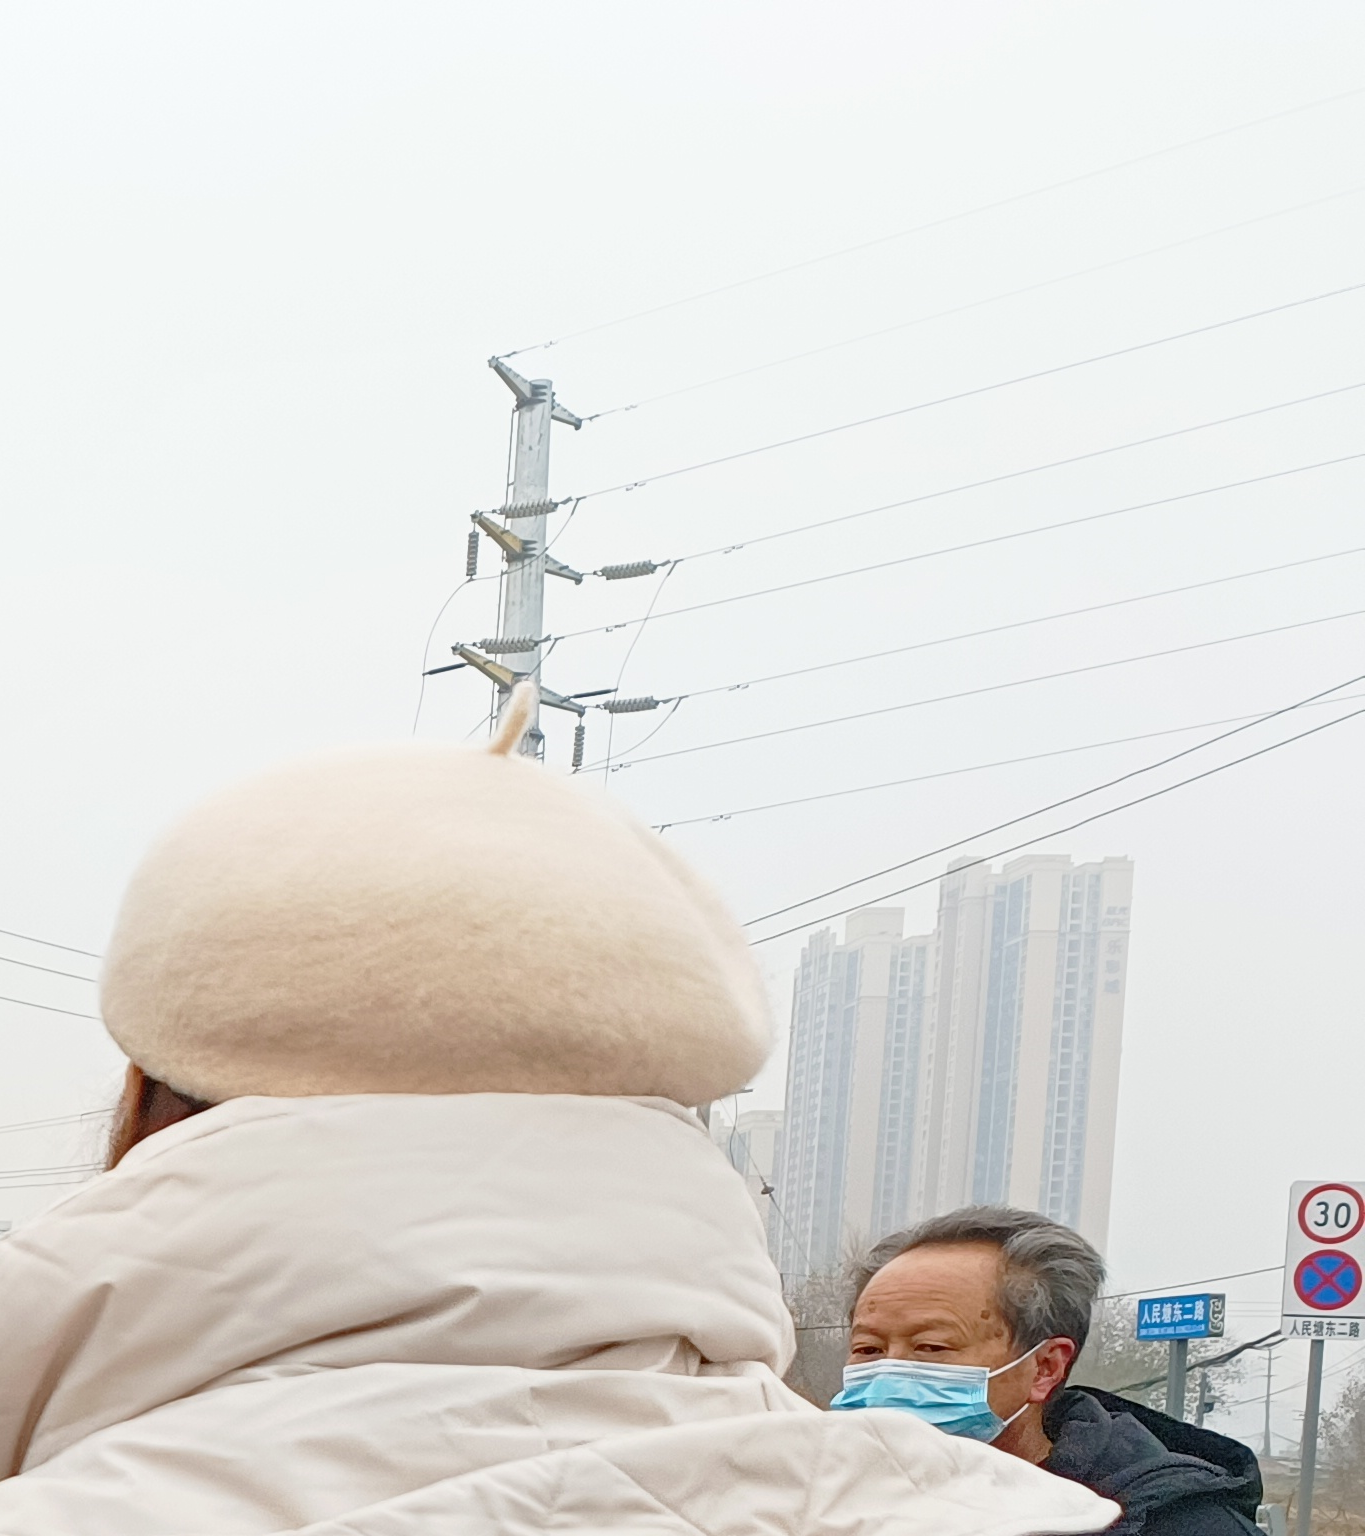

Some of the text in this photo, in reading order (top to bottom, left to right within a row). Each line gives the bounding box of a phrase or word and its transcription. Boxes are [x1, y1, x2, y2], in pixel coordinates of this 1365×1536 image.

[1313, 1201, 1351, 1229] 30
[1141, 1299, 1205, 1325] 人民塘东二路
[1289, 1319, 1360, 1338] 人民塘东二路
